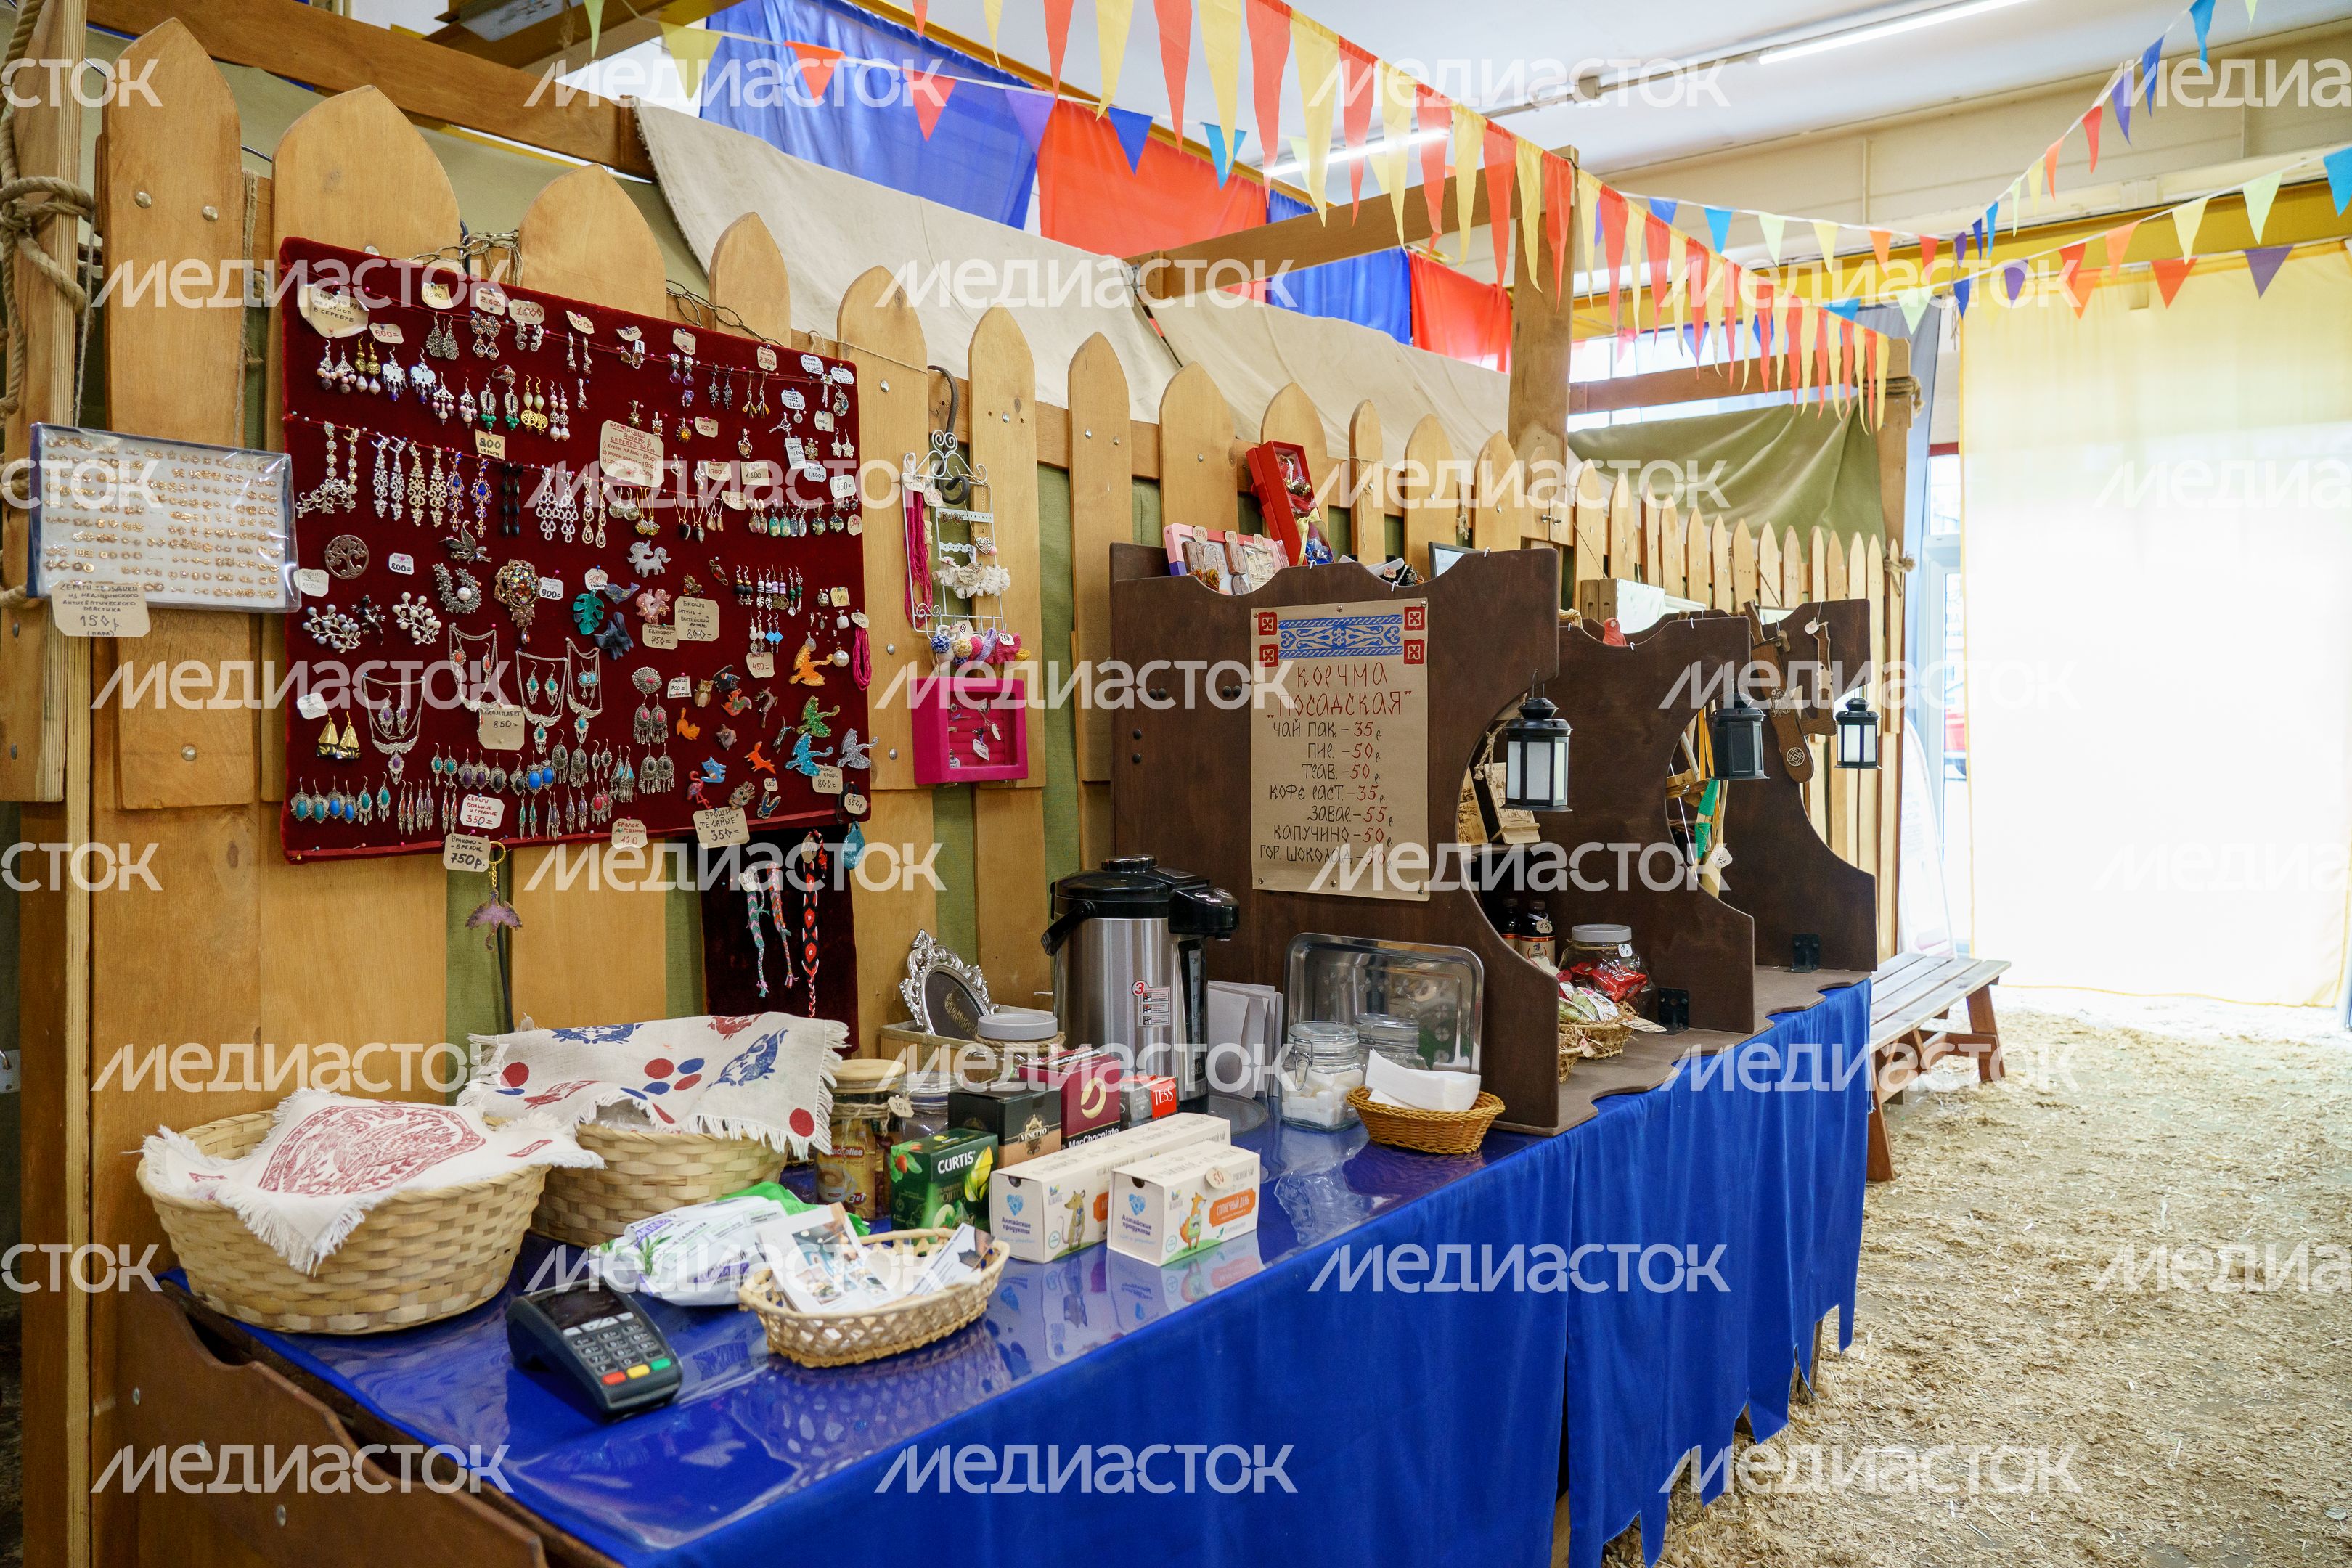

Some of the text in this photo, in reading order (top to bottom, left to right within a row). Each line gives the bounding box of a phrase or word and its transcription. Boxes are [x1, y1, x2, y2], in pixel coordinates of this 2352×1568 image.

[479, 437, 502, 449] 800
[391, 563, 412, 572] 800=
[542, 589, 561, 599] 900=
[752, 662, 770, 671] 450=
[1297, 661, 1388, 688] КОРЧМА
[1273, 719, 1302, 738] ЧАЙ
[1307, 722, 1337, 738] ПАК.
[817, 779, 836, 788] 800=
[1270, 783, 1305, 800] КОФЕ
[467, 795, 489, 804] СЕРЬГИ
[465, 814, 493, 825] 350=
[705, 809, 732, 819] БРОШИ
[711, 828, 740, 841] 350=
[1273, 825, 1349, 844] КАПУЧИНО
[1260, 845, 1282, 861] ГОР.
[1287, 846, 1353, 864] ШОКОЛАД
[1135, 981, 1145, 995] 3
[1154, 1086, 1174, 1106] TESS
[1021, 1127, 1048, 1142] VENETTO
[1069, 1126, 1120, 1149] MacChocolate
[830, 1148, 863, 1156] acCoffee
[937, 1150, 974, 1175] CURTIS
[1213, 1172, 1225, 1185] 50
[1002, 1216, 1032, 1228] Алтайские
[1122, 1214, 1152, 1230] Алтайские
[1122, 1221, 1151, 1236] продукты
[1003, 1224, 1030, 1235] продукты
